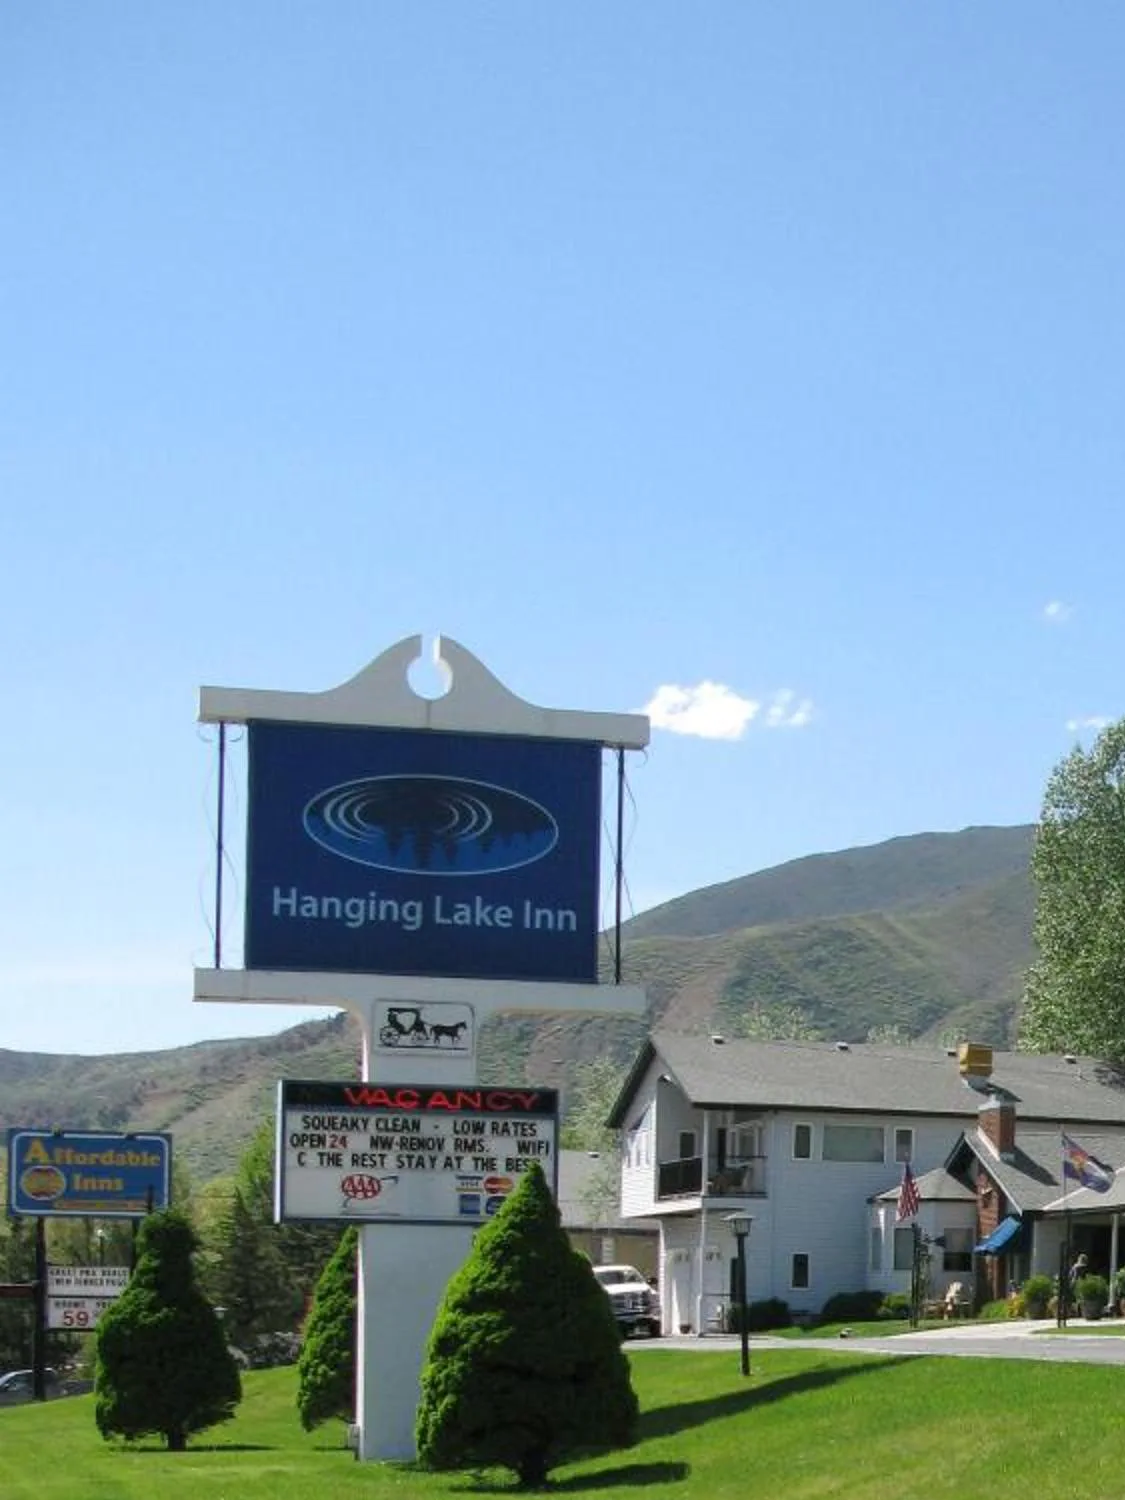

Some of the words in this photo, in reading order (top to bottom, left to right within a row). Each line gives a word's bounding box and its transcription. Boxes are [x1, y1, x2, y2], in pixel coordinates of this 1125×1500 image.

[271, 886, 423, 932] Hanging
[434, 896, 513, 929] Lake
[523, 901, 577, 931] Inn
[345, 1088, 539, 1110] VACANCY
[302, 1114, 370, 1133] SQUEAKY
[375, 1117, 421, 1133] CLEAN
[453, 1119, 487, 1135] LOW
[491, 1121, 537, 1137] RATES
[24, 1138, 160, 1166] Affordable
[290, 1133, 327, 1149] OPEN
[328, 1134, 348, 1149] 24
[453, 1138, 490, 1154] RMS.
[517, 1140, 550, 1155] WIFI
[297, 1153, 306, 1167] C
[317, 1152, 343, 1168] THE
[351, 1153, 386, 1169] REST
[396, 1154, 437, 1169] STAY
[443, 1155, 465, 1170] AT
[473, 1156, 498, 1172] THE
[74, 1174, 123, 1190] Inns
[343, 1175, 379, 1194] AAA
[63, 1310, 89, 1327] 59
